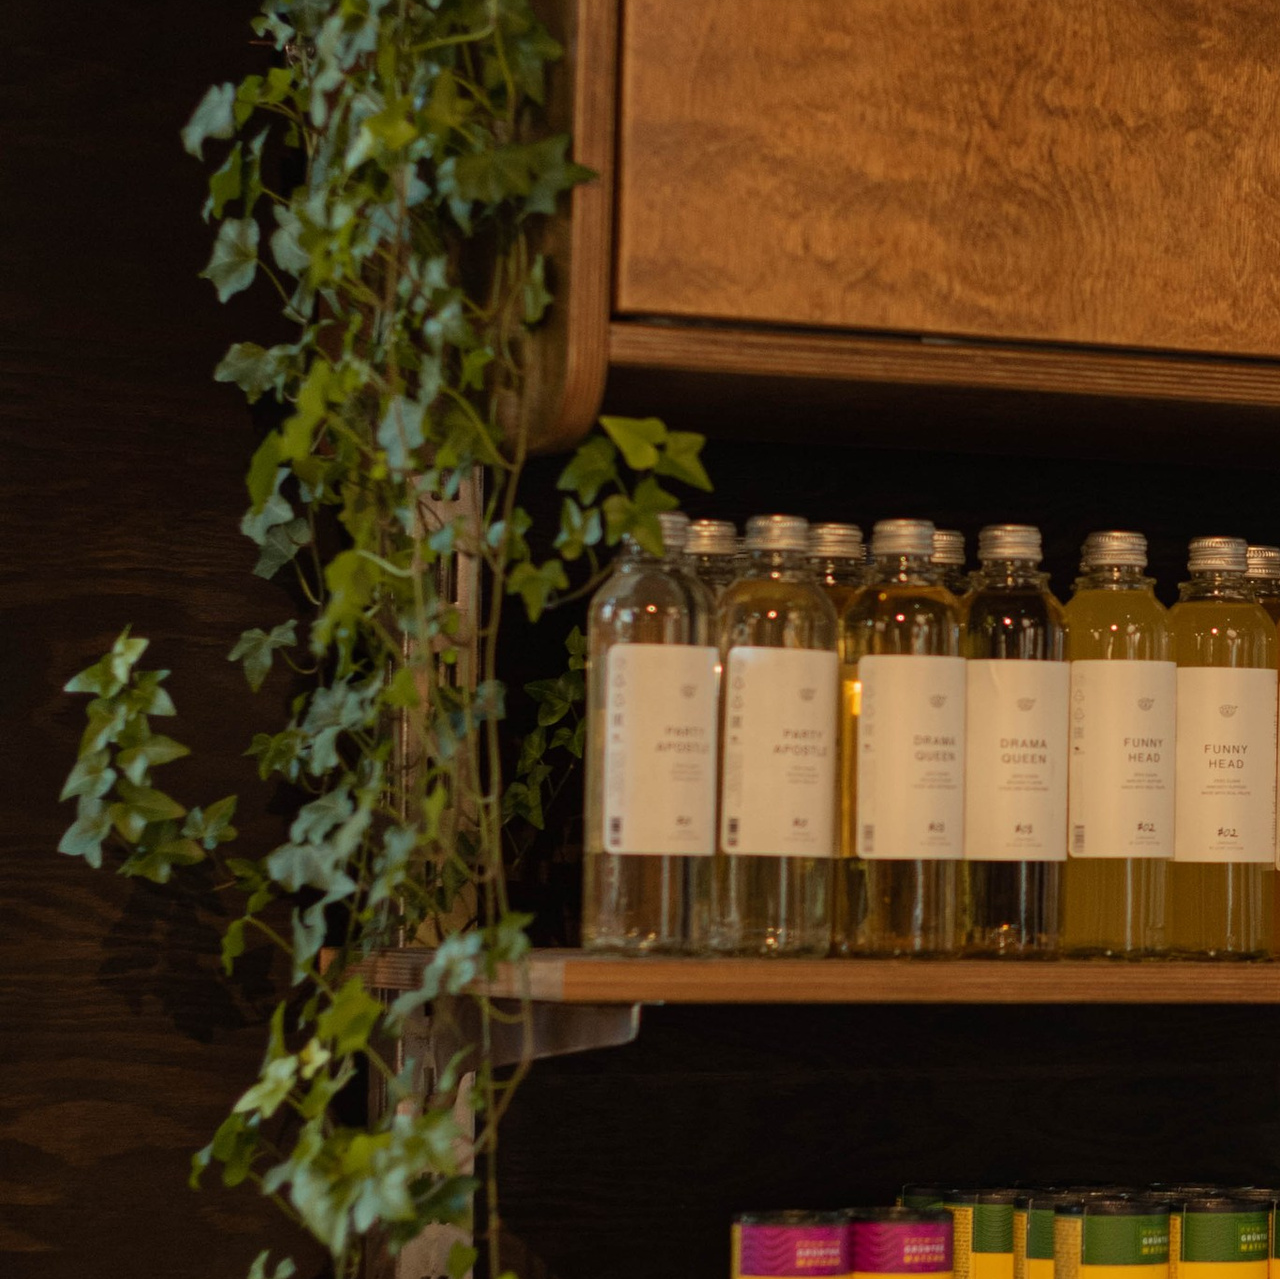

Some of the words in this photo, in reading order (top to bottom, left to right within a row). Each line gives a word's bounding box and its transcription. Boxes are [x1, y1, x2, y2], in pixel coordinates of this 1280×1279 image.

[913, 735, 956, 746] DRAMA
[1000, 738, 1048, 749] DRAMA
[1123, 738, 1164, 748] FUNNY
[1204, 744, 1248, 755] FUNNY
[914, 750, 956, 762] QUEEN
[1001, 754, 1047, 765] QUEEN
[1128, 753, 1161, 763] HEAD
[1208, 759, 1245, 769] HEAD
